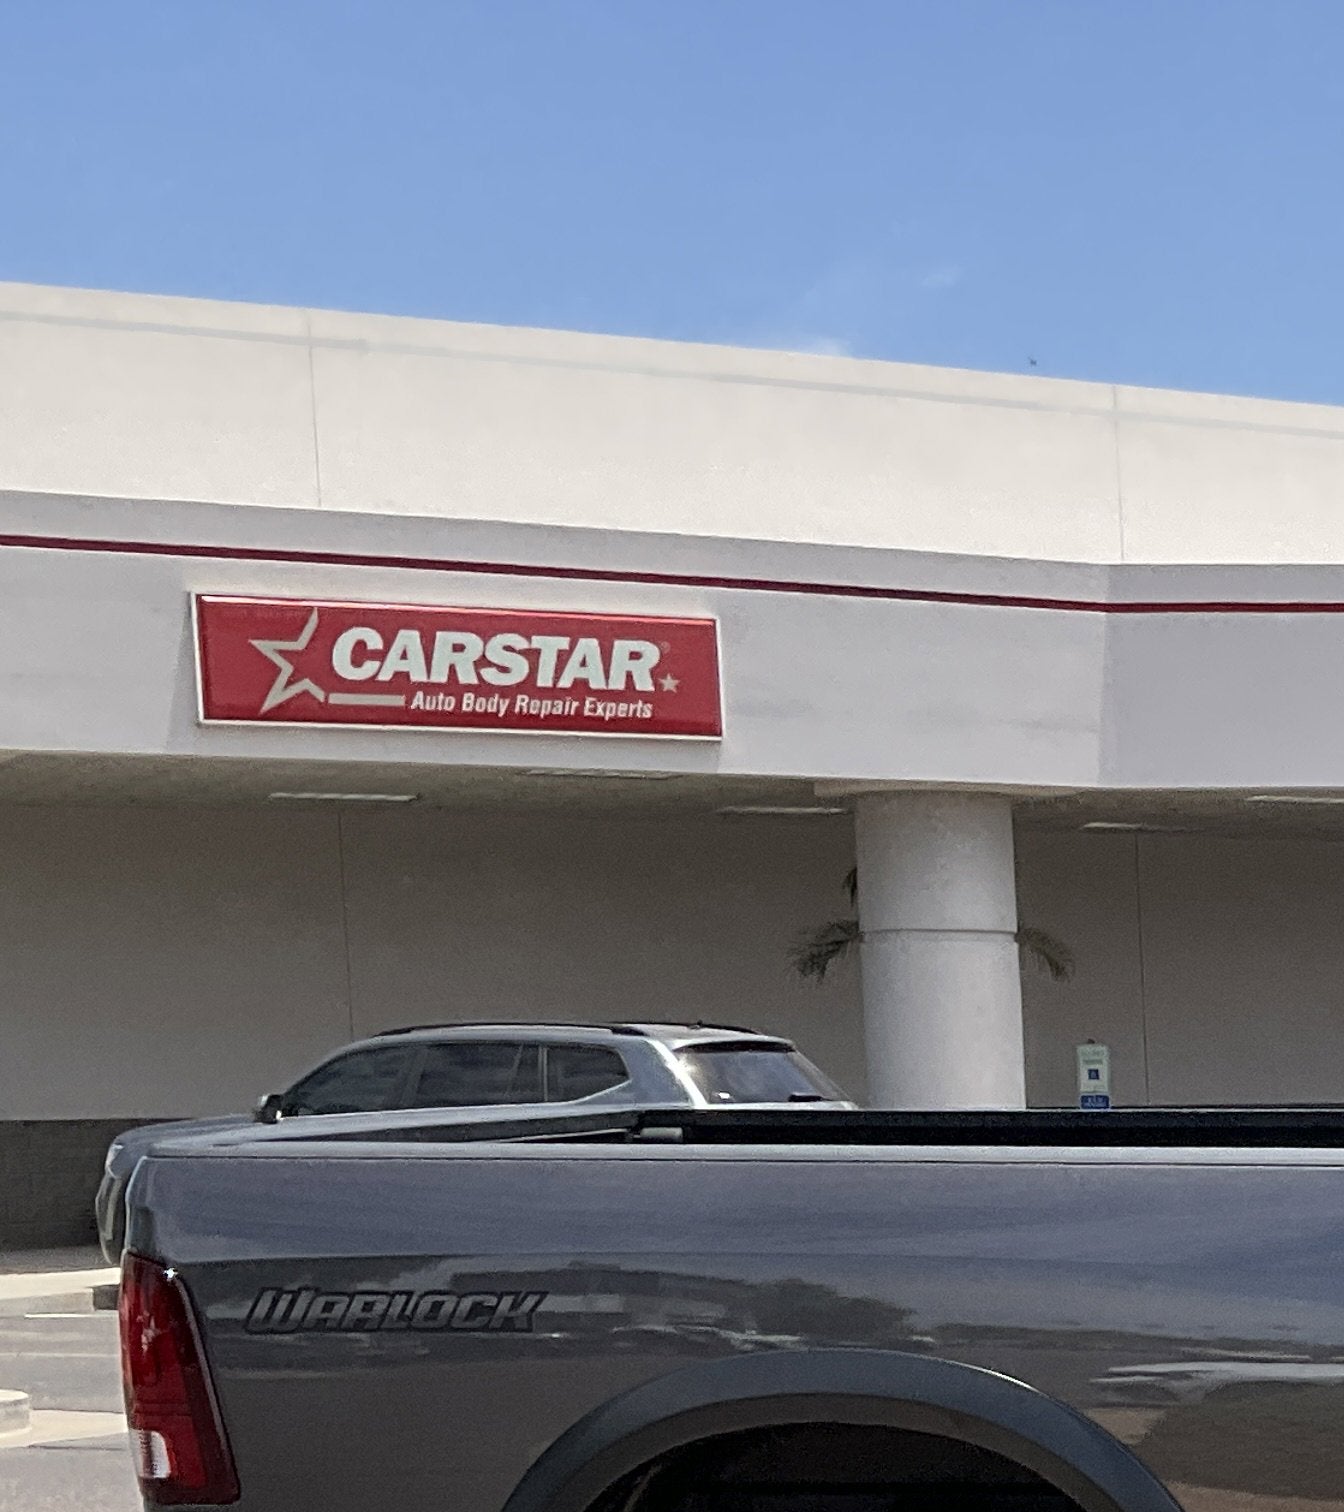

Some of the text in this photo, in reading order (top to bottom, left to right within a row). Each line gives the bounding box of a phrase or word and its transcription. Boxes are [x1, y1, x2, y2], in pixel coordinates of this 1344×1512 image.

[332, 626, 661, 692] CARSTAR
[410, 690, 653, 721] Auto Body Repair Experts
[245, 1286, 550, 1335] WARLOCK
